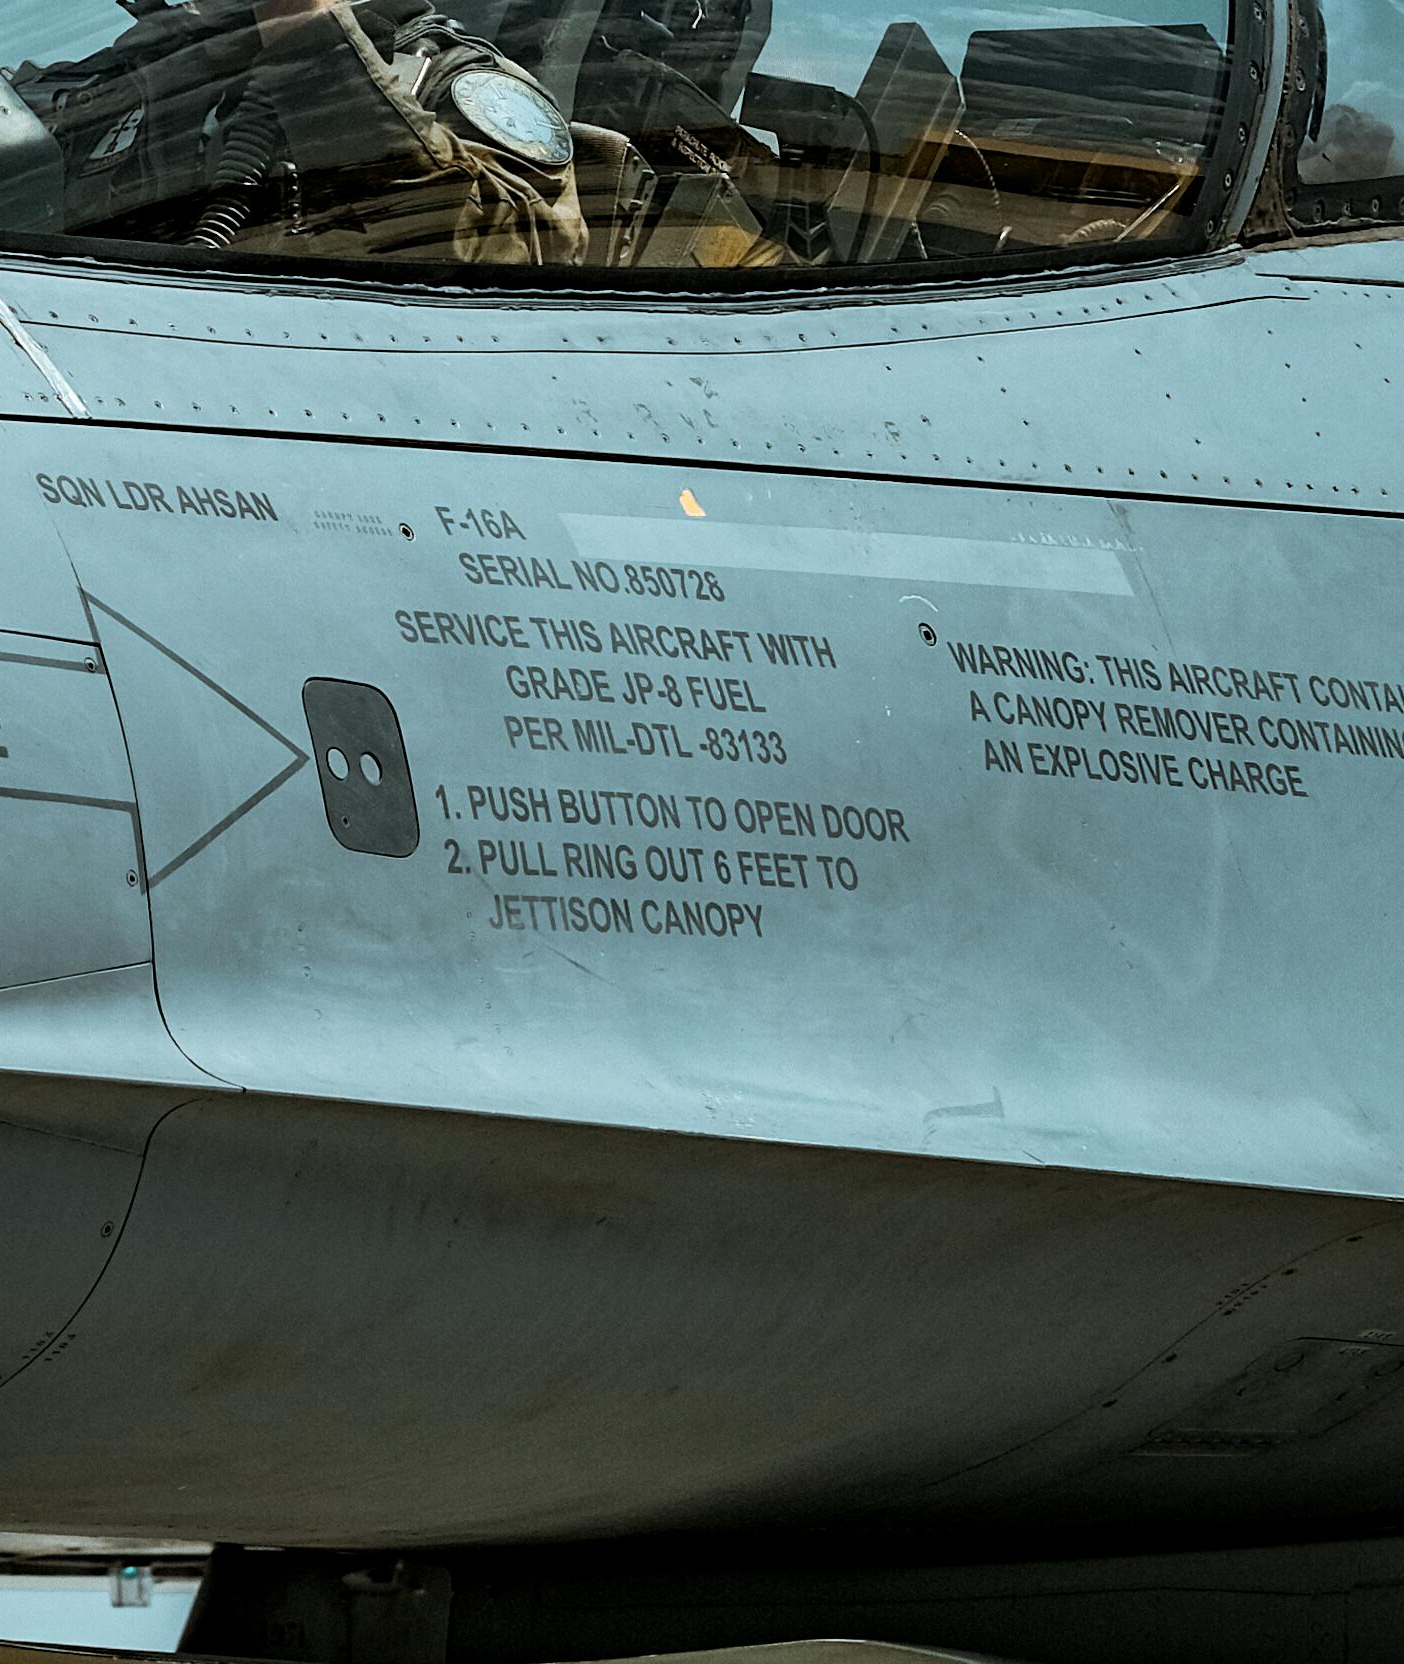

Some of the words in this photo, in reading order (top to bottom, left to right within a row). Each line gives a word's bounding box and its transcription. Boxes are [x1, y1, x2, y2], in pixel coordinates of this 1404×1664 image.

[36, 472, 107, 509] SQN
[104, 479, 175, 514] LDR
[176, 485, 280, 523] AHSAN
[434, 505, 528, 541] F-16A
[458, 552, 574, 591] SERIAL
[571, 559, 726, 603] NO.850728
[394, 609, 530, 650] SERVICE
[528, 617, 604, 654] THIS
[609, 622, 755, 664] AIRCRAFT
[755, 631, 838, 670] WITH
[505, 664, 617, 705] GRADE
[621, 671, 684, 709] JP-8
[684, 675, 768, 714] FUEL
[946, 640, 1096, 685] WARNING:
[1095, 653, 1164, 693] THIS
[1167, 661, 1303, 705] AIRCRAFT
[503, 715, 569, 753] PER
[572, 718, 695, 760] MIL-DTL
[698, 726, 789, 766] -83133
[969, 689, 993, 724] A
[992, 691, 1108, 734] CANOPY
[1113, 701, 1257, 747] REMOVER
[1256, 714, 1404, 760] CONTAININ
[983, 738, 1025, 775] AN
[1026, 741, 1185, 788] EXPLOSIVE
[1186, 755, 1310, 799] CHARGE
[434, 783, 463, 821] 1.
[466, 785, 553, 824] PUSH
[556, 788, 682, 830] BUTTON
[684, 795, 729, 833] TO
[733, 797, 818, 839] OPEN
[820, 804, 912, 844] DOOR
[443, 837, 472, 876] 2.
[477, 839, 559, 878] PULL
[562, 841, 639, 882] RING
[644, 845, 706, 885] OUT
[713, 849, 732, 886] 6
[737, 851, 810, 890] FEET
[815, 854, 860, 893] TO
[487, 894, 634, 935] JETTISON
[640, 899, 765, 938] CANOPY
